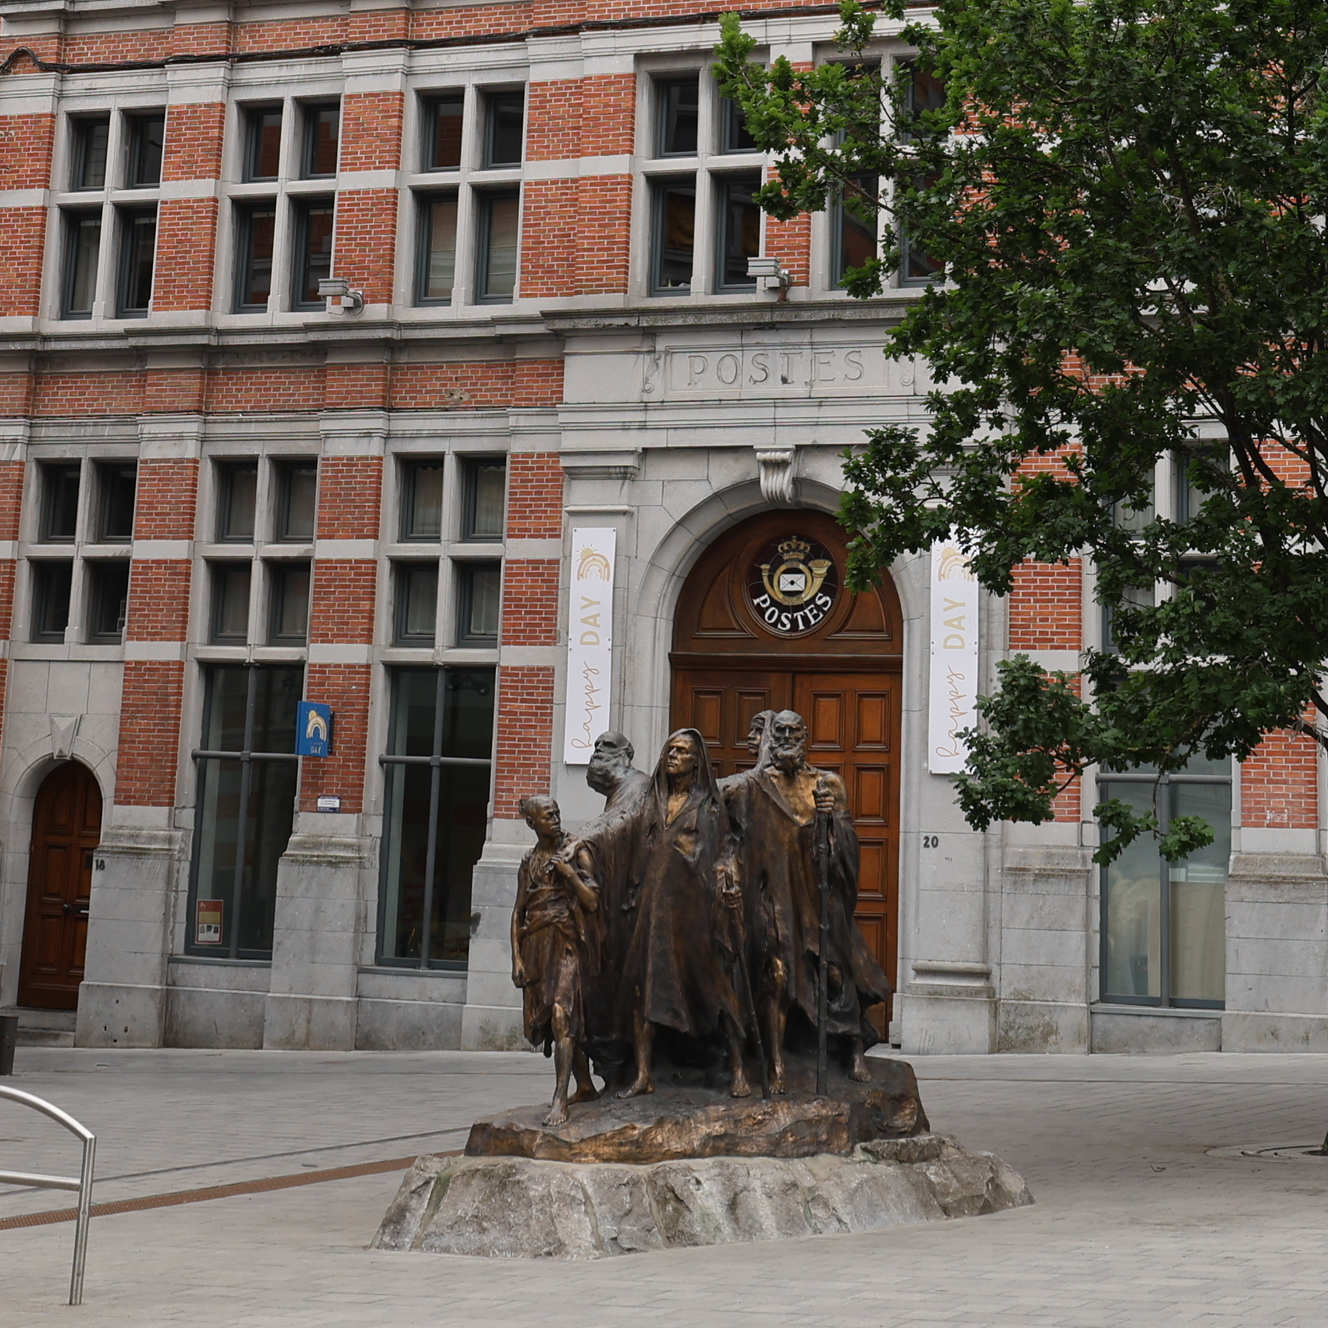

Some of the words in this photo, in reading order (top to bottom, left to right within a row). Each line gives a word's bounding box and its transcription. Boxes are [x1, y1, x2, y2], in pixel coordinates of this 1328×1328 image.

[687, 350, 864, 386] POSTES
[580, 596, 600, 646] DAY
[753, 593, 832, 630] POSTES
[943, 598, 966, 649] DAY
[923, 835, 939, 848] 20
